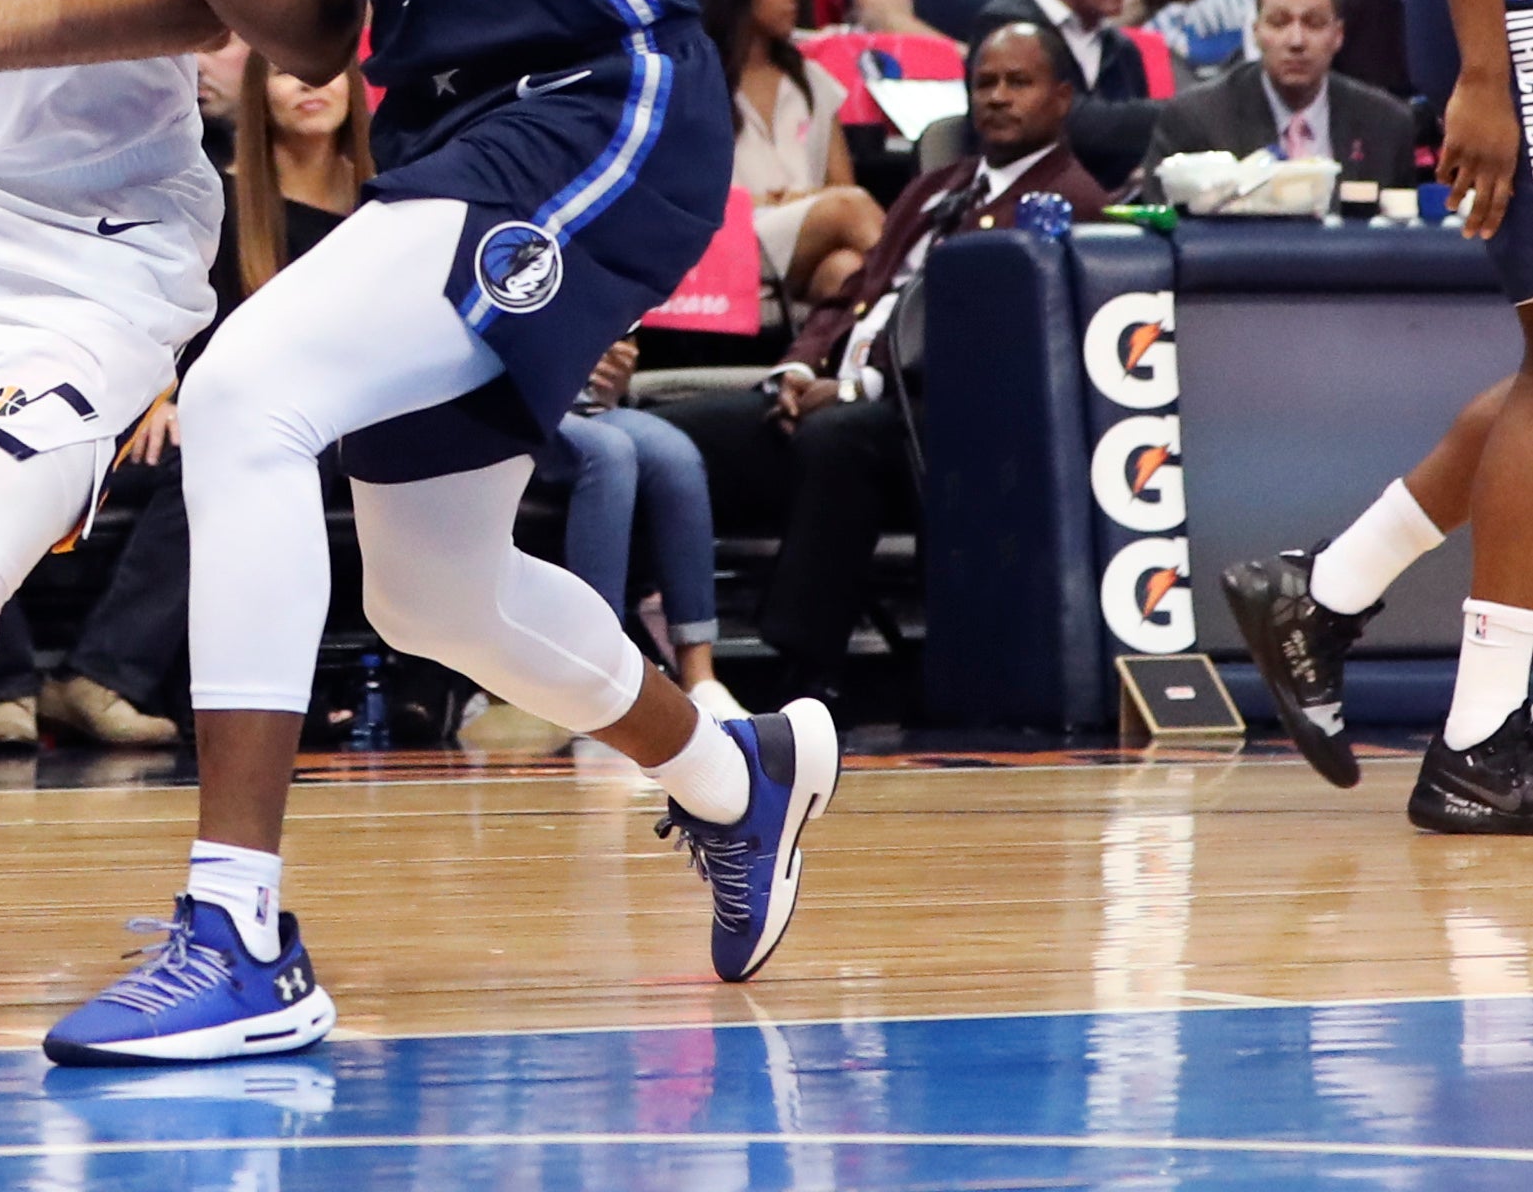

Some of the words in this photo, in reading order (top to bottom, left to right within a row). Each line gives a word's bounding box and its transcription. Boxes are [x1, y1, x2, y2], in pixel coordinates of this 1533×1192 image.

[1084, 291, 1179, 409] G
[1091, 415, 1186, 532] G
[1101, 537, 1196, 654] G
